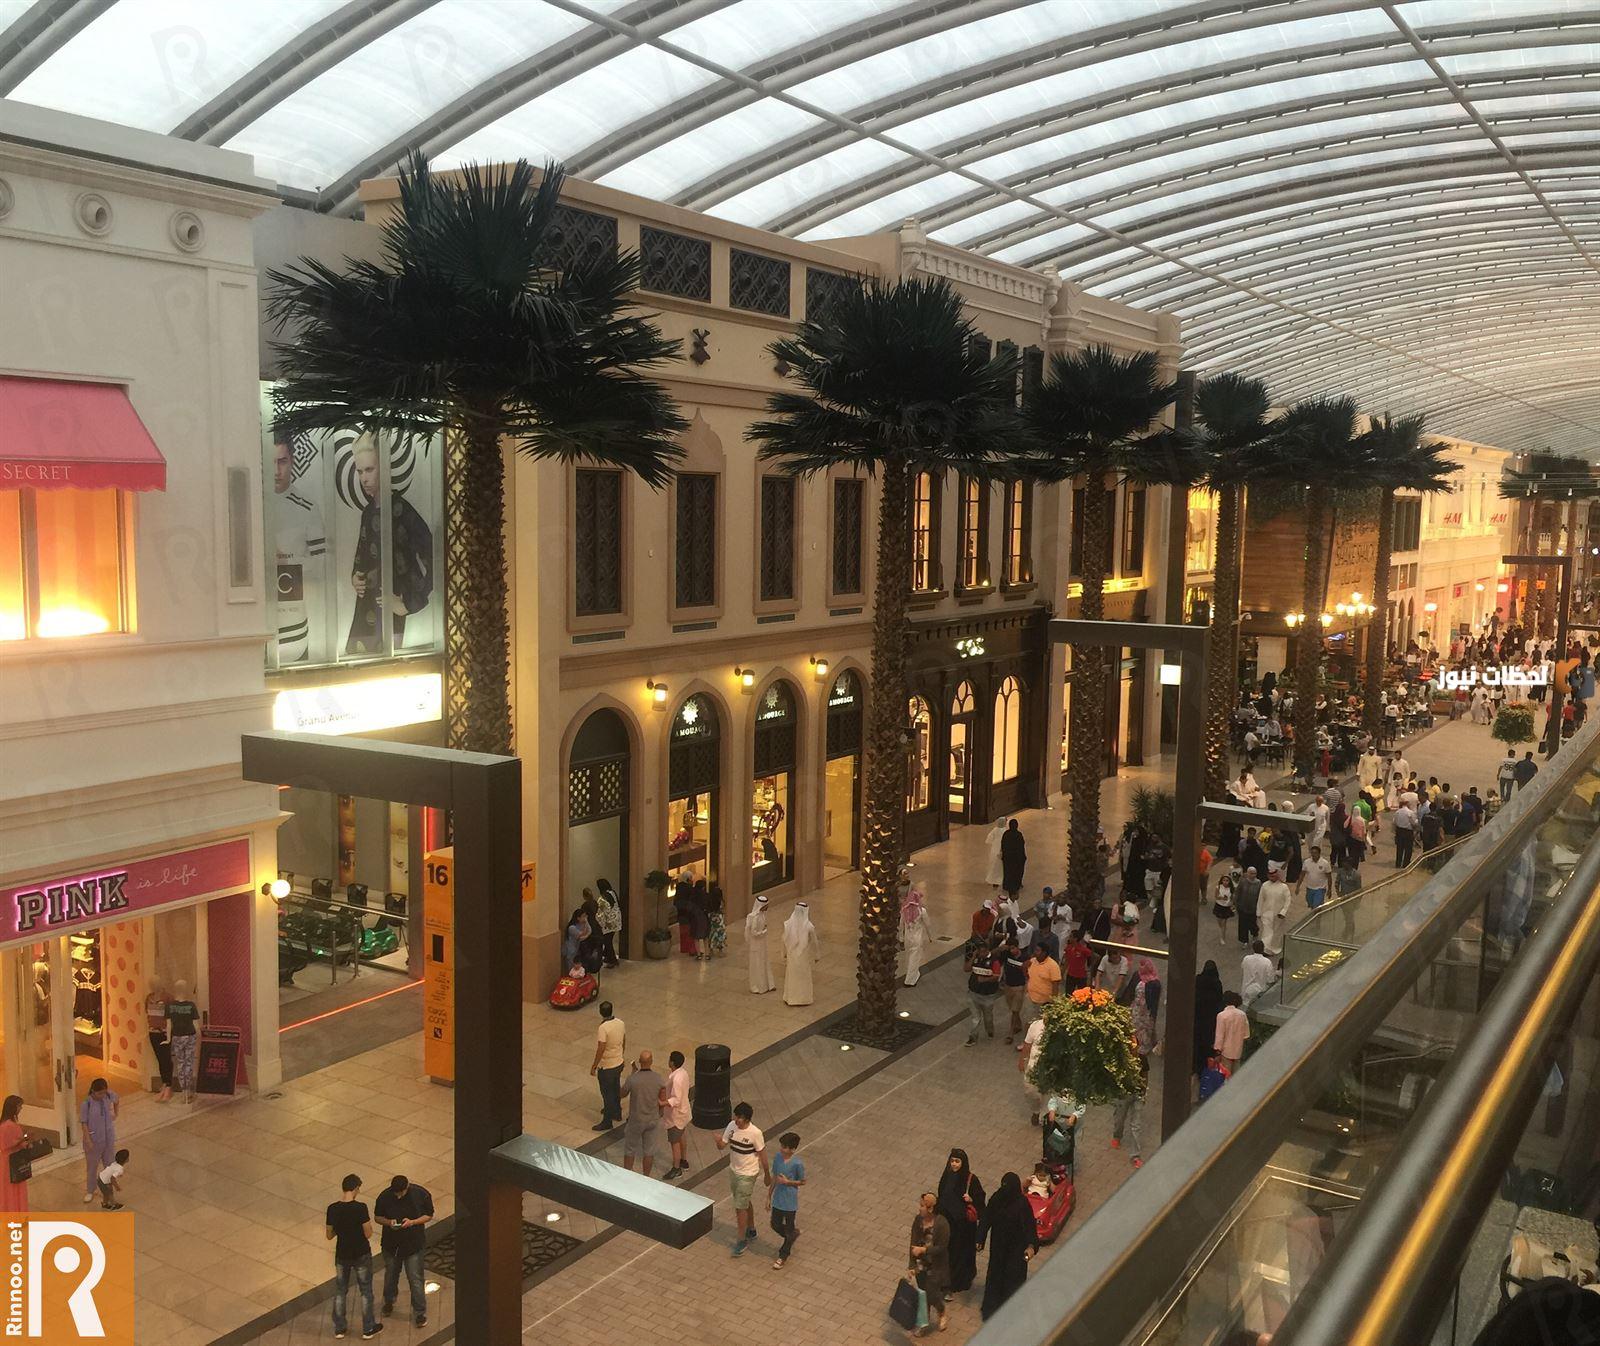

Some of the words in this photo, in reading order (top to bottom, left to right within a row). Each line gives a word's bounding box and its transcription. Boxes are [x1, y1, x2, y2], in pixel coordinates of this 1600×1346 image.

[3, 463, 71, 480] SECRET
[427, 863, 448, 886] 16
[16, 871, 129, 932] PINK
[136, 877, 154, 889] is
[155, 864, 199, 885] life
